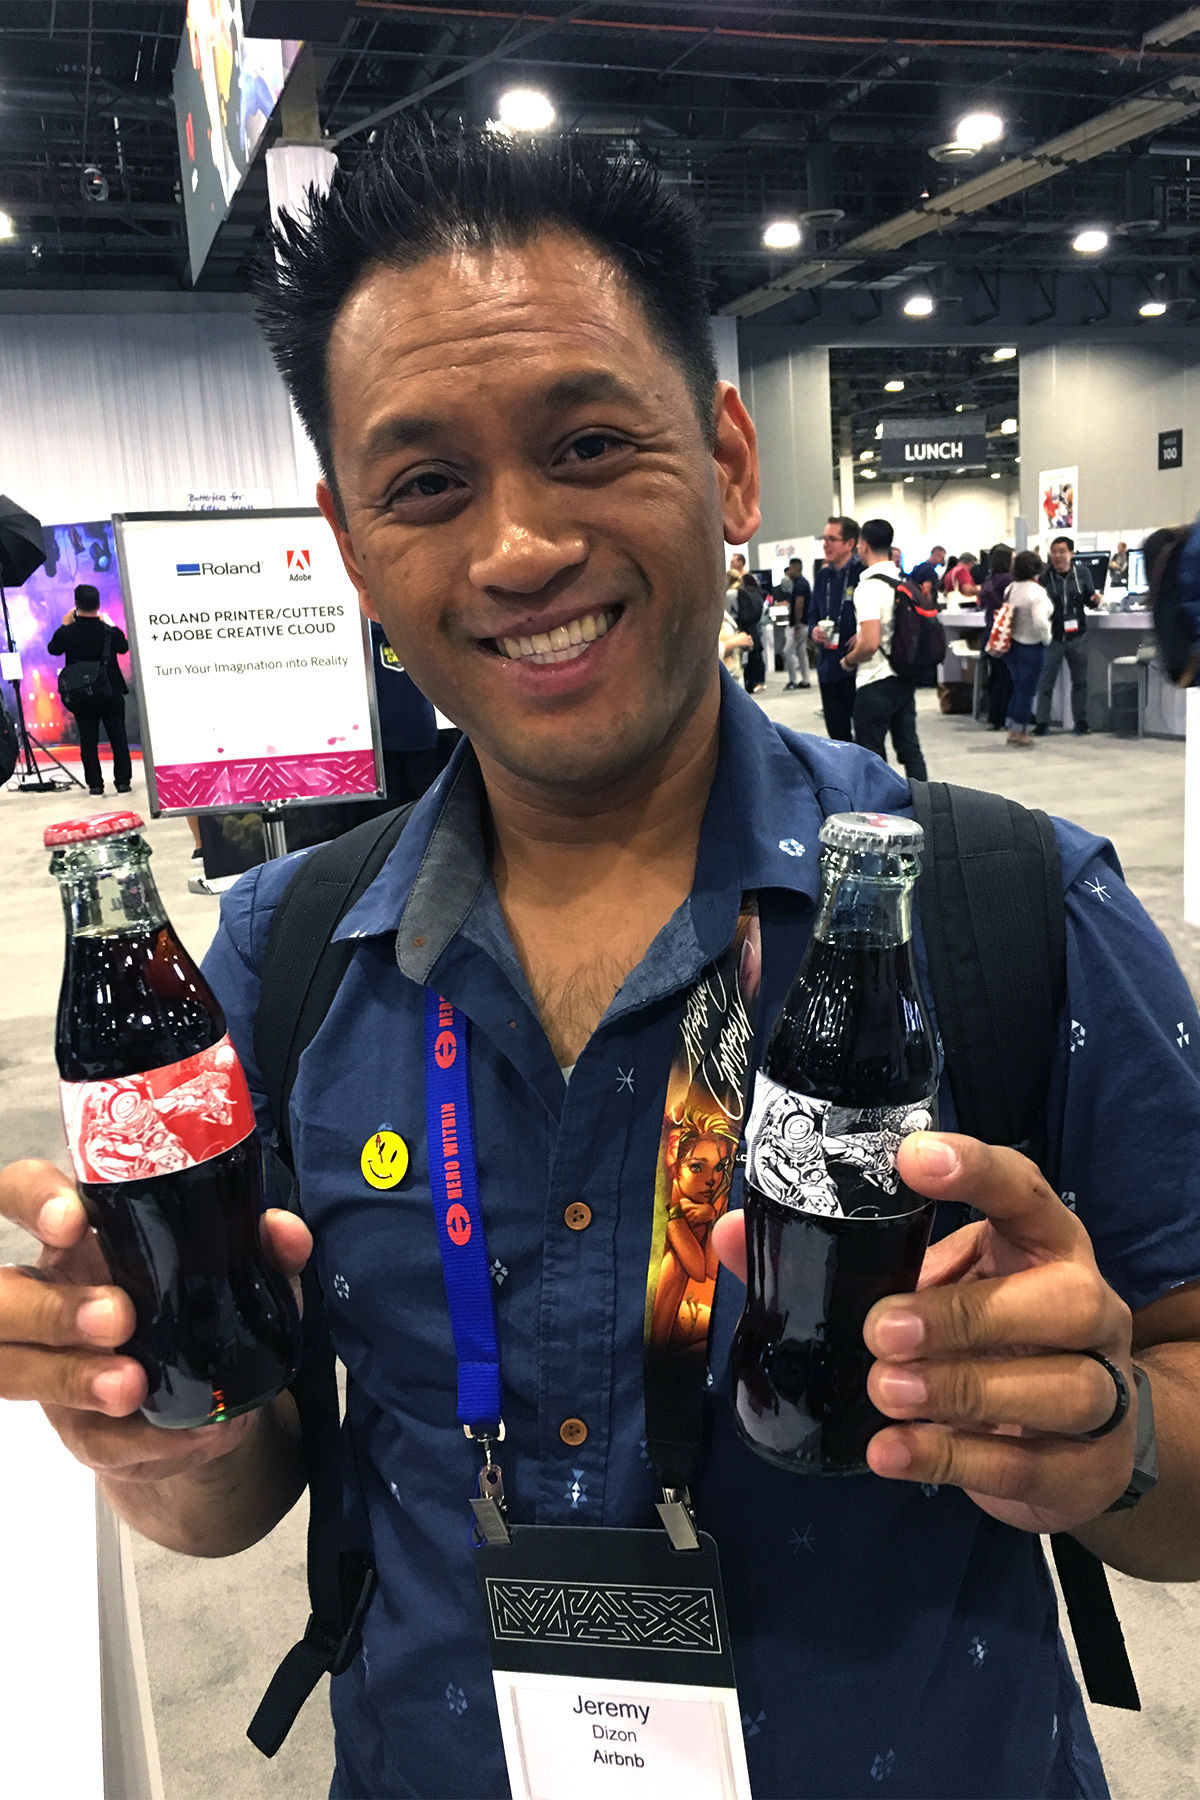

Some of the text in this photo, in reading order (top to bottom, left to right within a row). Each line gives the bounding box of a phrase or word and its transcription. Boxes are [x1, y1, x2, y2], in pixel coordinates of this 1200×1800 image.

[904, 442, 963, 461] LUNCH
[1163, 447, 1178, 460] 100
[202, 561, 261, 575] Roland
[149, 605, 345, 625] ROLAND PRINTER/CUTTERS
[163, 629, 213, 642] ADOBE
[217, 625, 284, 639] CREATIVE
[287, 622, 336, 636] CLOUD
[155, 655, 348, 676] Turn Your Imagination into Reality
[440, 1103, 463, 1200] HERO WITHIN
[573, 1695, 650, 1725] Jeremy
[592, 1724, 637, 1742] Dizon
[593, 1749, 645, 1768] Airbnb
